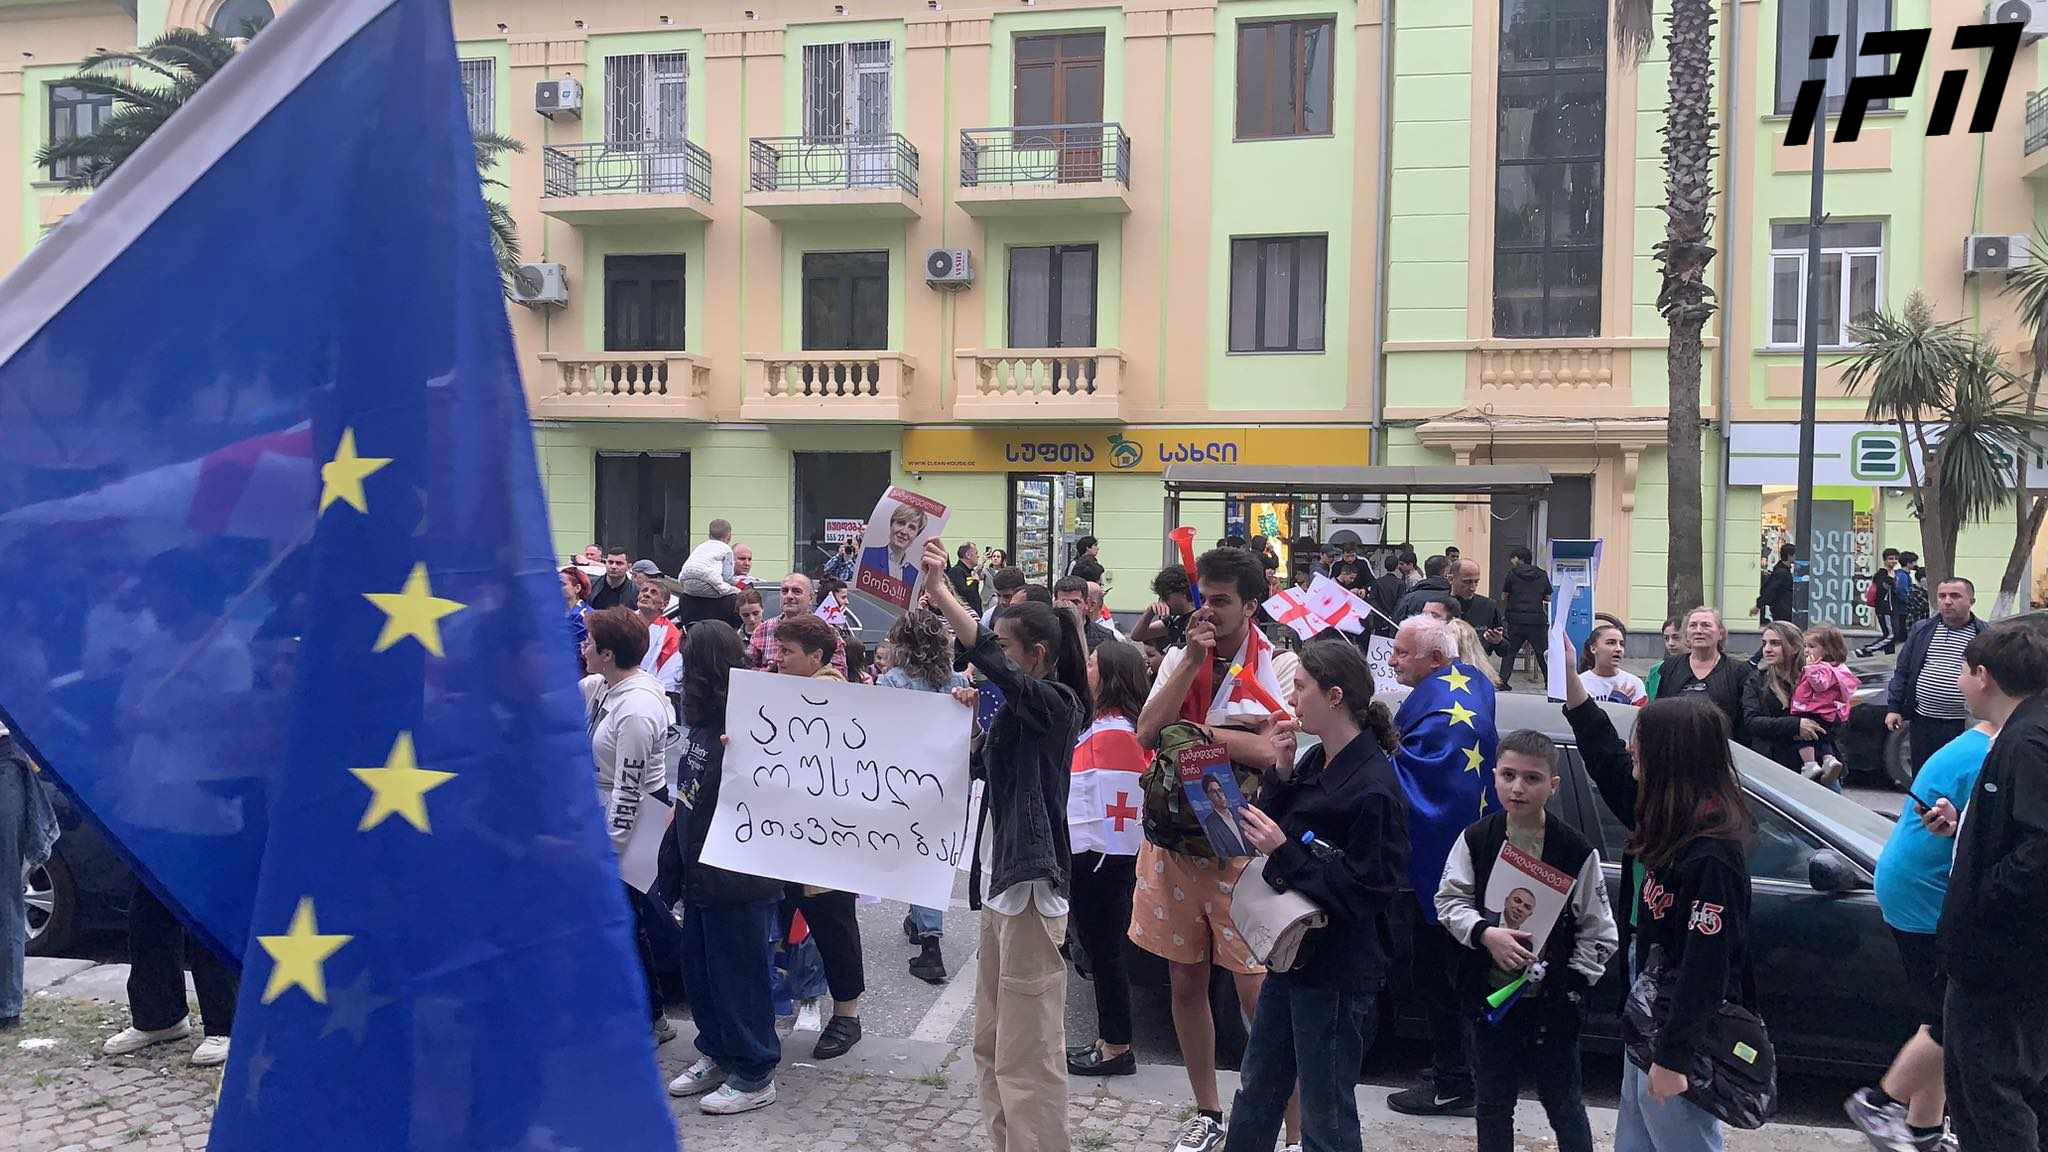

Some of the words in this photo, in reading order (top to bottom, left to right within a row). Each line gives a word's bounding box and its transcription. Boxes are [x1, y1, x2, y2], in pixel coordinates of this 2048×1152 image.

[1005, 443, 1095, 463] სუფთა
[1159, 443, 1237, 462] სახლი
[862, 570, 907, 600] მონა!!!
[750, 694, 866, 750] არა
[753, 747, 944, 810] რუსულ
